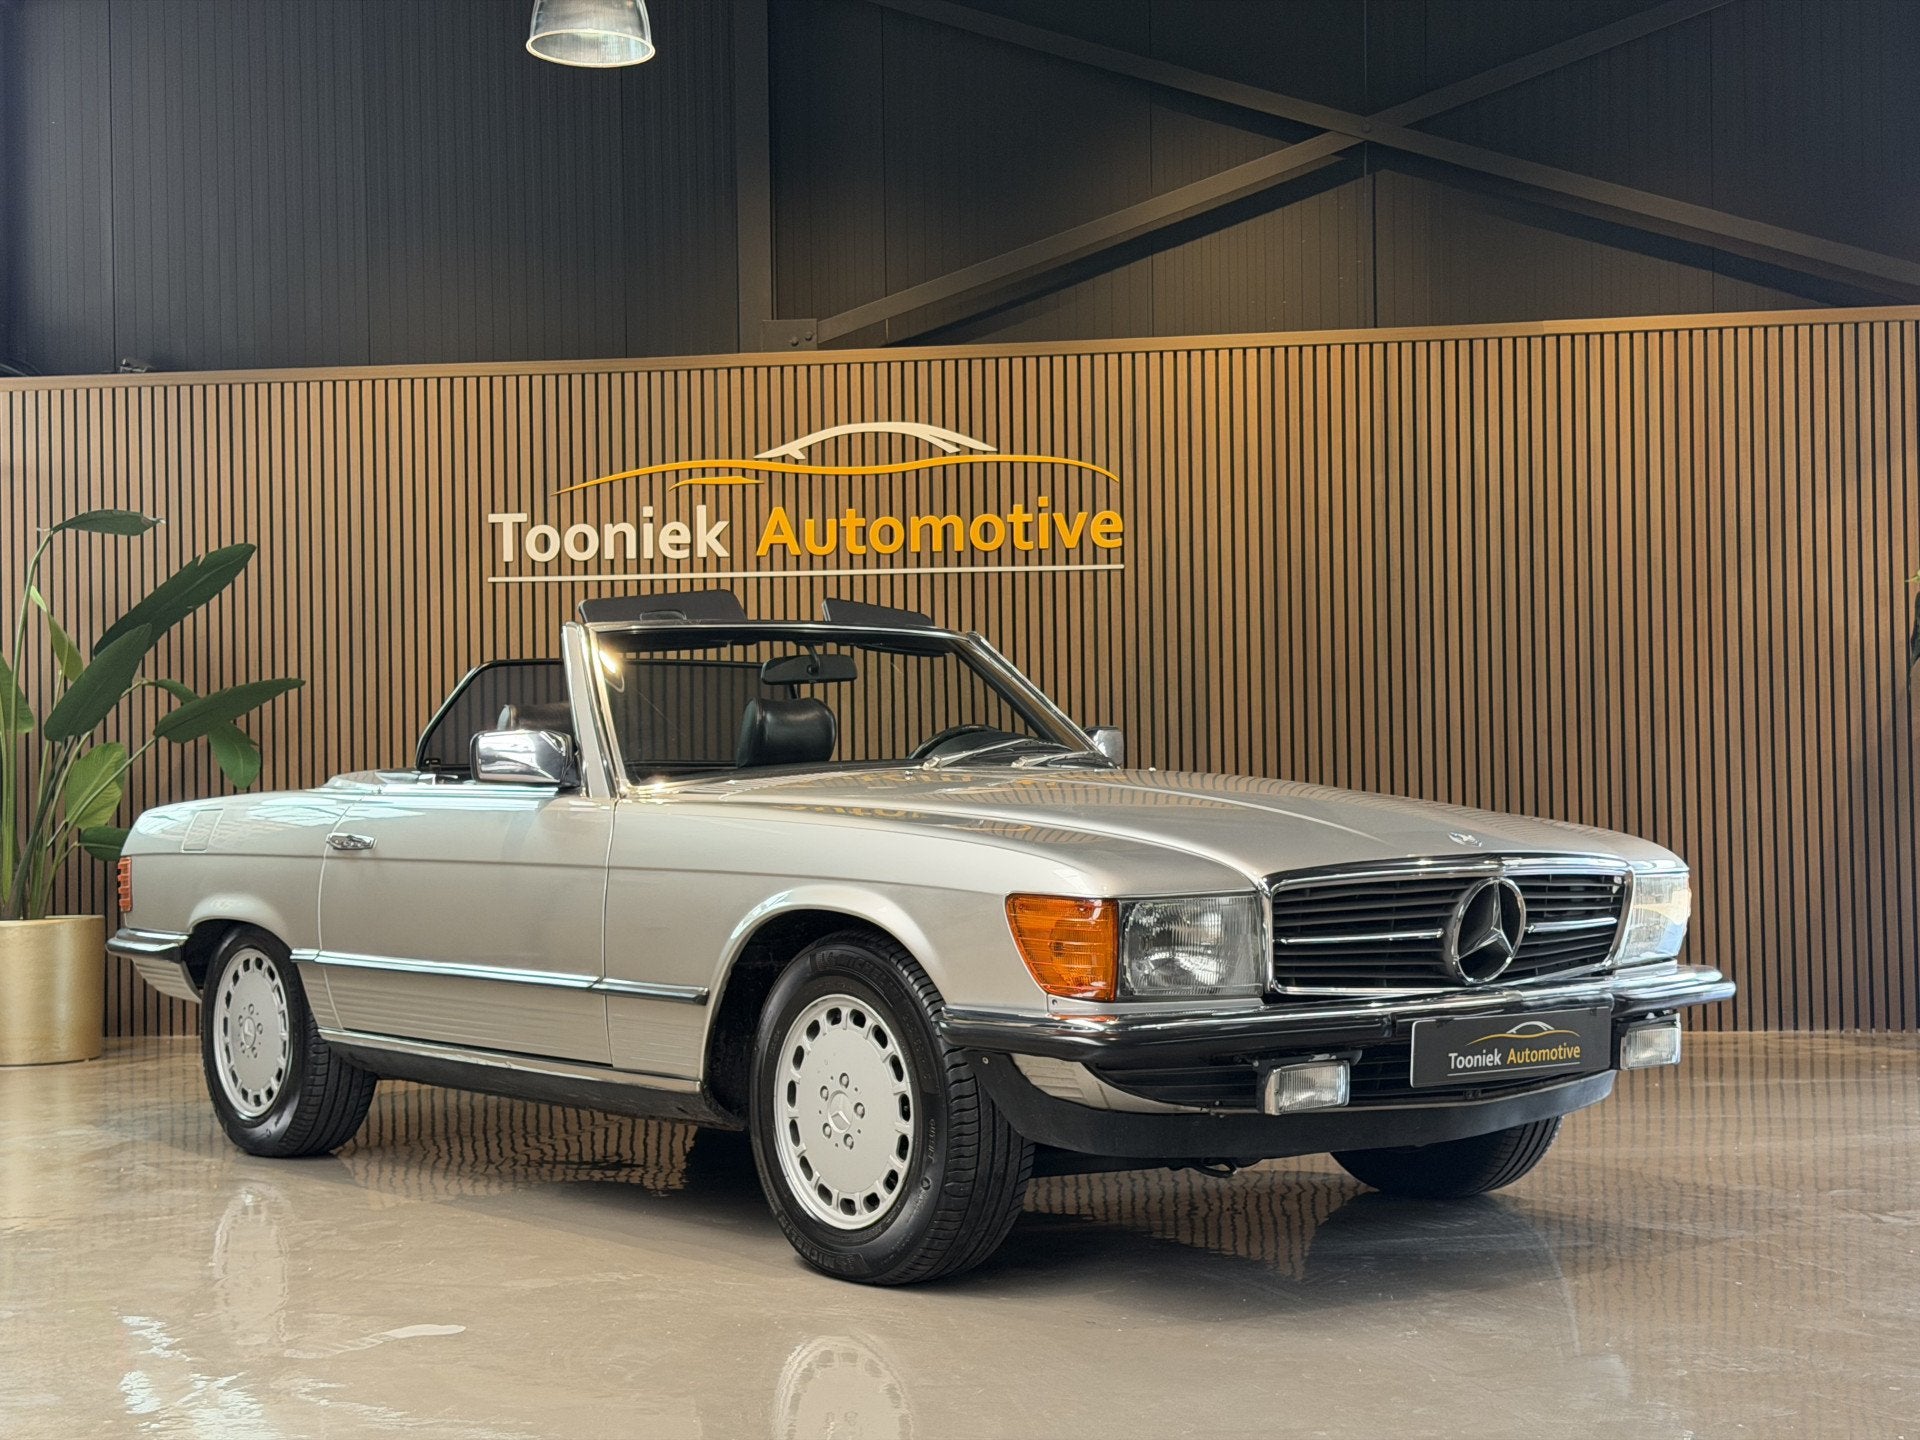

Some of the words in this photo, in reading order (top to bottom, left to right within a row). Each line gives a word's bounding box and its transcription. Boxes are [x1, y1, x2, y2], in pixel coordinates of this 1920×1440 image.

[487, 504, 731, 563] Tooniek
[755, 496, 1124, 558] Automotive
[1448, 1049, 1502, 1069] Tooniek
[1506, 1042, 1581, 1065] Automotive
